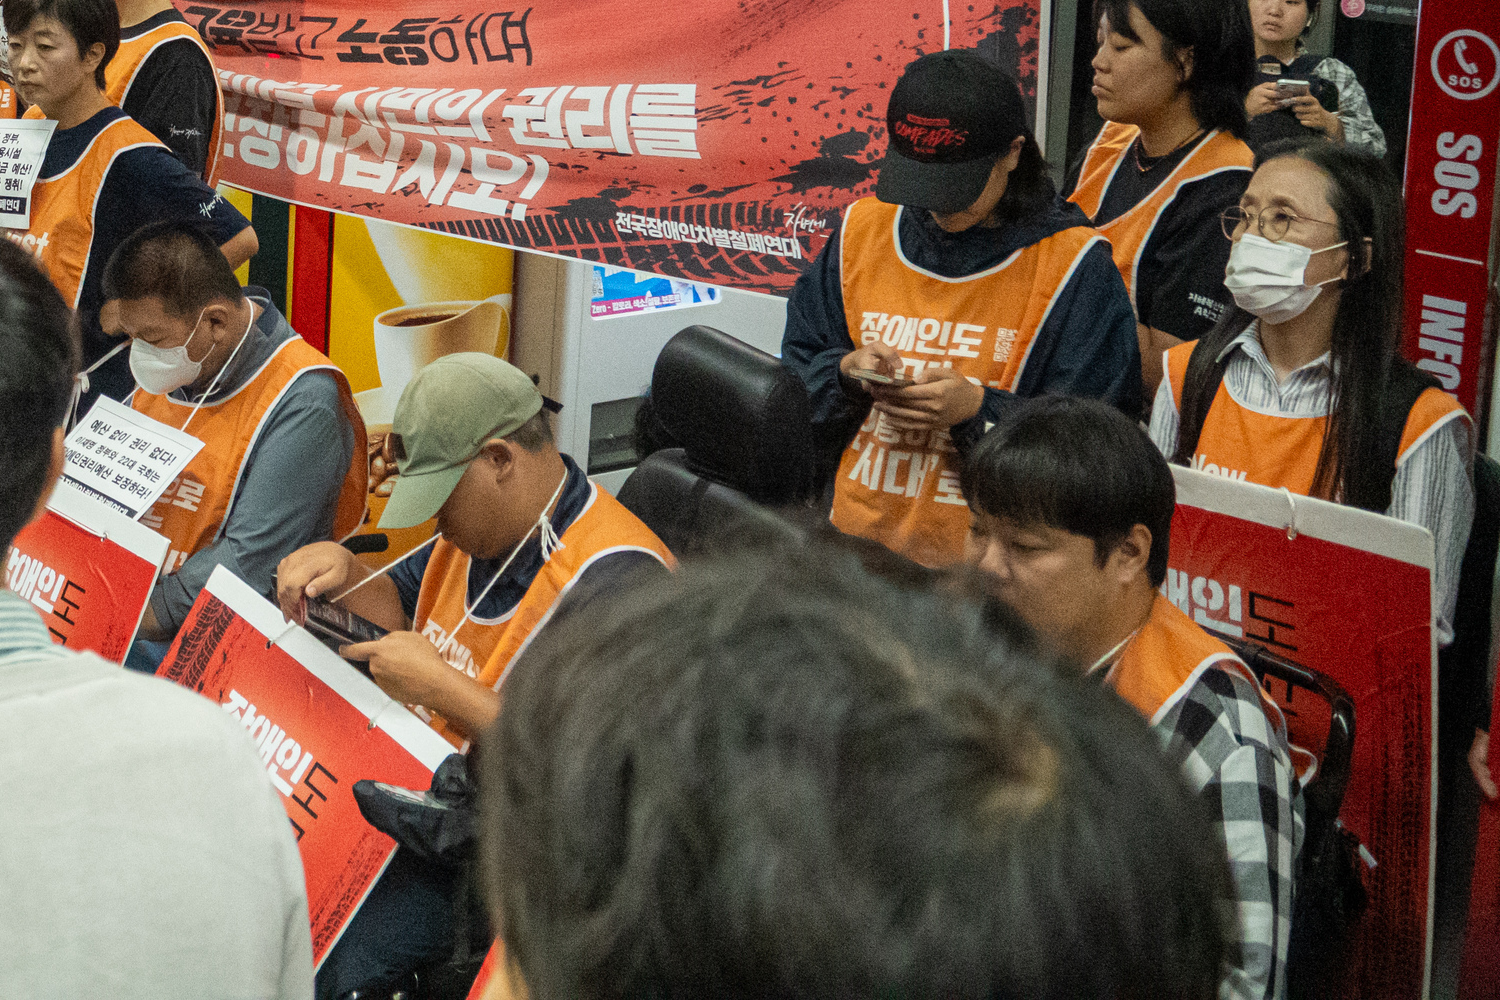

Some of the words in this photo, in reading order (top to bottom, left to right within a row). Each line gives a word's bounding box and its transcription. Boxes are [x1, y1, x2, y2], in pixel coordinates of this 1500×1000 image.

[336, 7, 534, 66] 노동하며
[1447, 74, 1483, 90] SOS
[1, 133, 20, 144] 정부,
[331, 84, 507, 143] 시민의
[502, 82, 703, 160] 권리를
[11, 163, 33, 176] 예산!
[223, 95, 550, 221] 장하십시오!
[1431, 131, 1483, 220] SOS
[4, 177, 24, 192] 쟁취!
[615, 211, 802, 260] 전국장애인차별철폐연대
[591, 303, 607, 315] Zero
[859, 311, 987, 359] 장애인도
[75, 436, 98, 450] 이재명
[95, 445, 119, 461] 정부와
[117, 455, 138, 470] 22대
[136, 464, 161, 484] 국회는
[90, 419, 112, 436] 예산
[108, 429, 132, 445] 없이
[128, 437, 151, 454] 권리
[148, 446, 177, 467] 없다!
[111, 473, 153, 500] 보장하라!
[1160, 567, 1298, 652] 애인도
